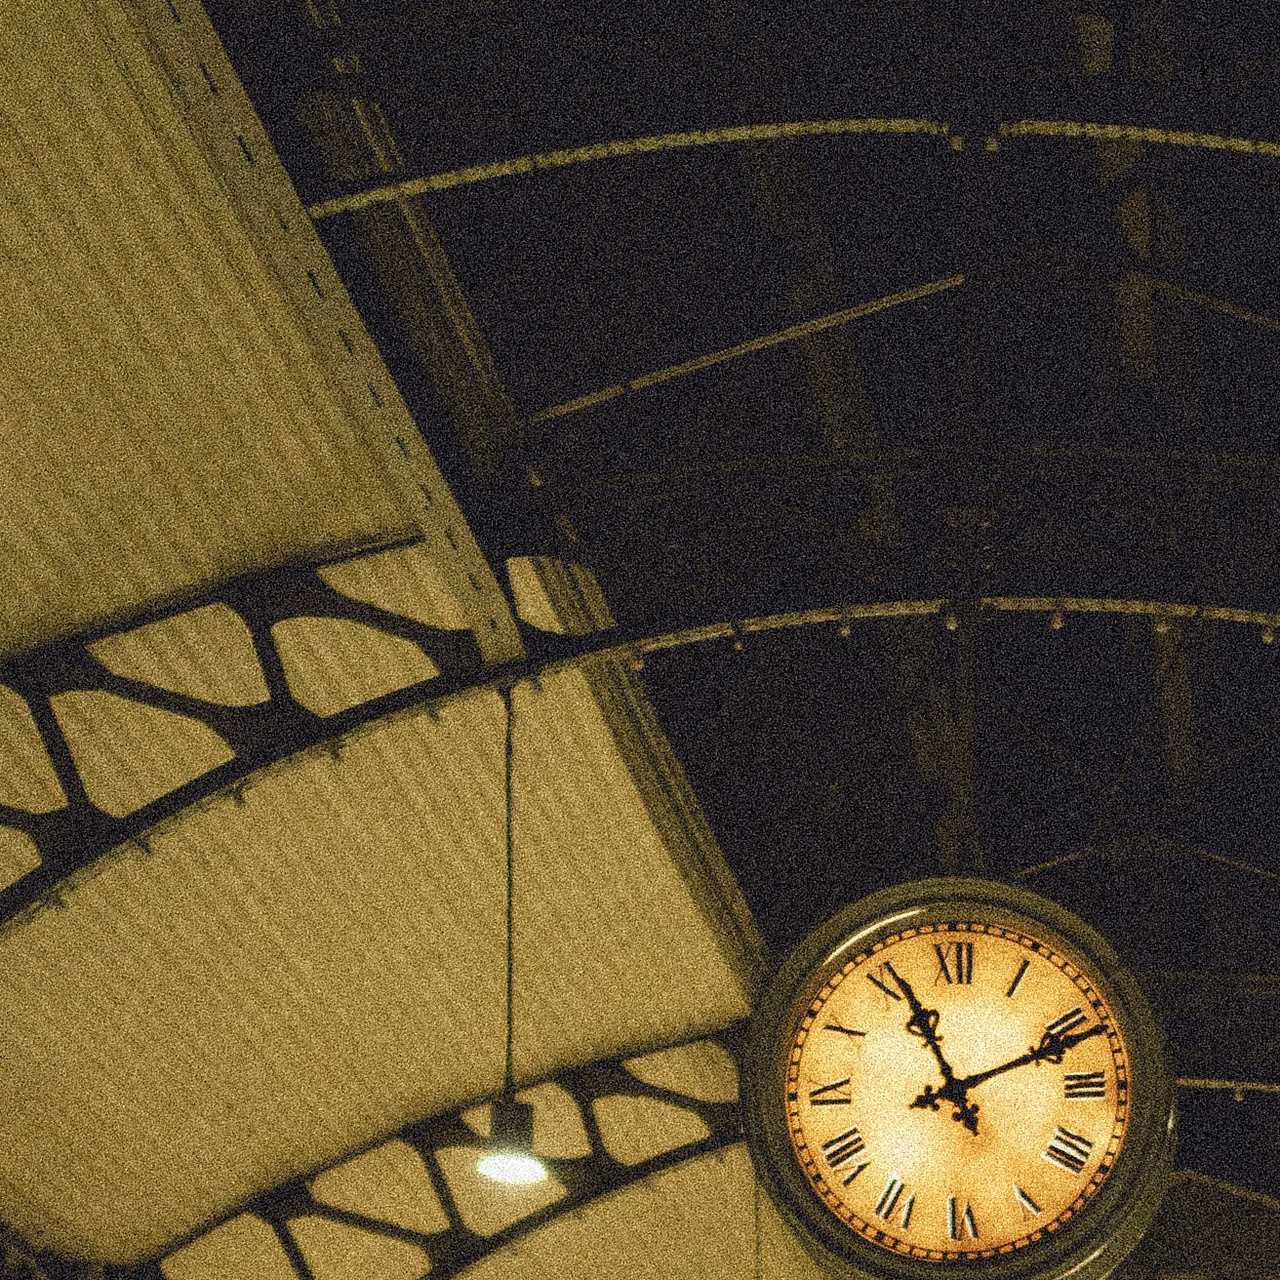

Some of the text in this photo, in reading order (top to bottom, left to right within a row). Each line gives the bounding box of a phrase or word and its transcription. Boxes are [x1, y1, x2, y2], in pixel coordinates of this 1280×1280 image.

[932, 941, 974, 986] XII
[1005, 959, 1031, 998] I
[1064, 1069, 1106, 1099] III
[822, 1126, 873, 1188] VIII
[1042, 1126, 1094, 1174] IIII
